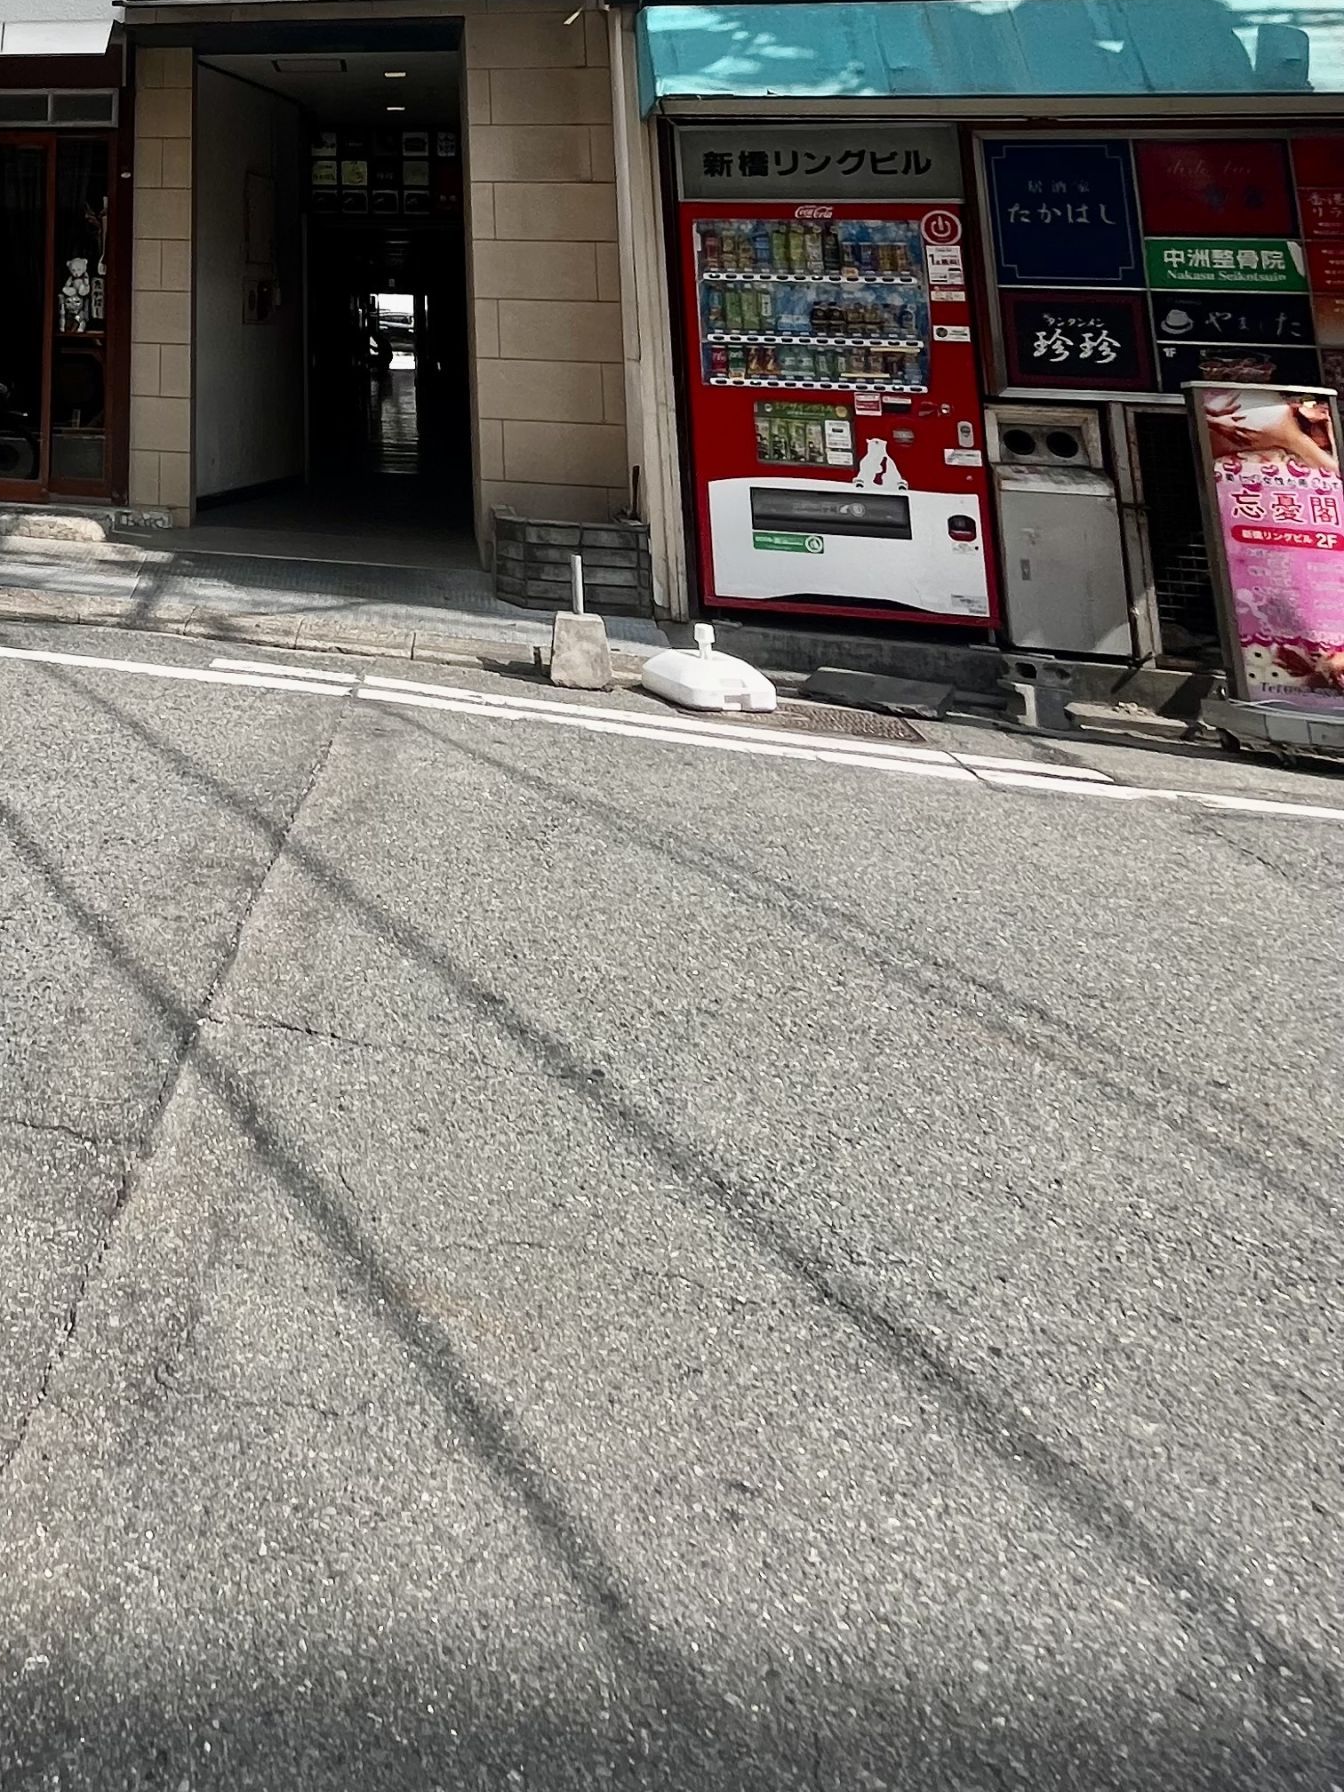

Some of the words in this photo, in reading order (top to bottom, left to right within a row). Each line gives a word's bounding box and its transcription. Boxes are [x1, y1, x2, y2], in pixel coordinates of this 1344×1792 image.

[703, 149, 932, 178] 新橋リングビル
[1008, 203, 1117, 224] たかはし
[1163, 248, 1286, 271] 中洲整骨院
[1167, 269, 1215, 281] Nakasu
[1217, 271, 1287, 282] Seikotsuin
[1033, 328, 1122, 364] 珍珍
[1231, 489, 1341, 526] 忘憂閣
[1315, 532, 1338, 550] 2F
